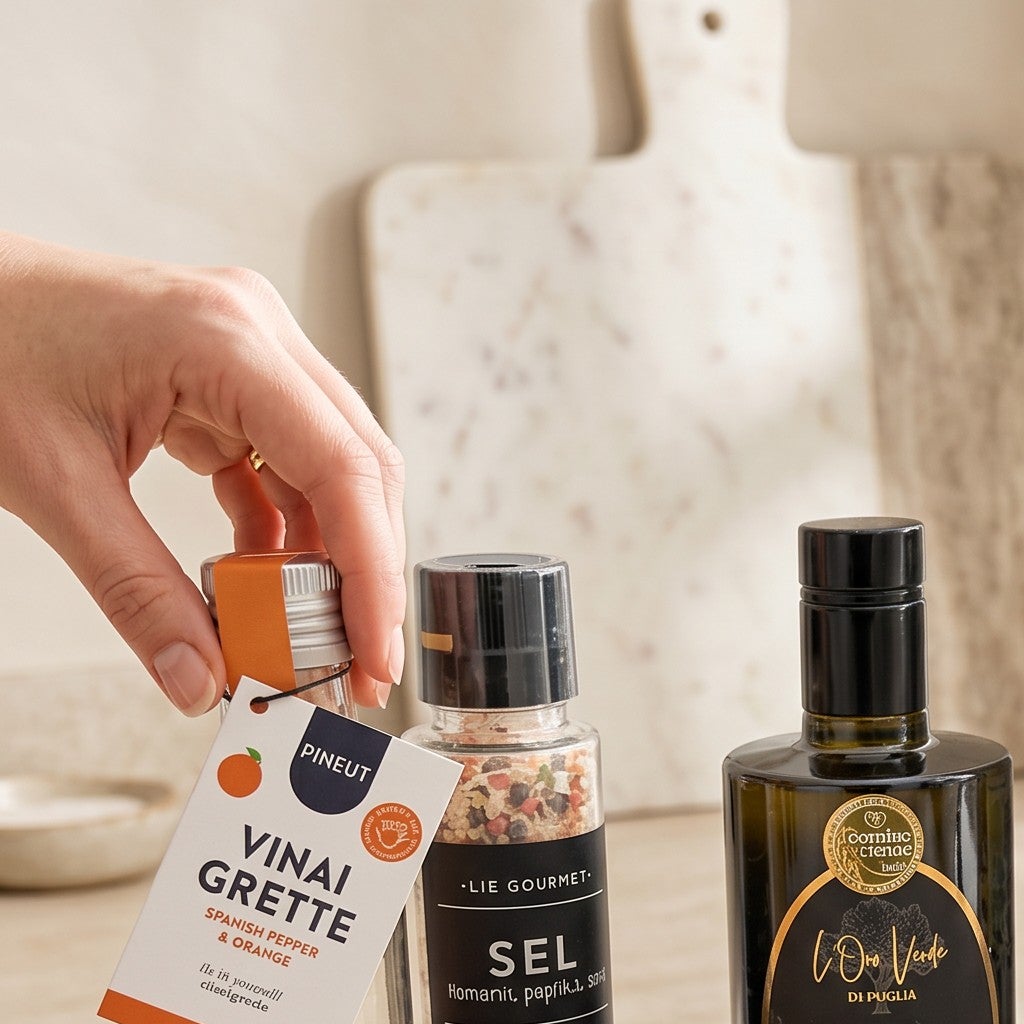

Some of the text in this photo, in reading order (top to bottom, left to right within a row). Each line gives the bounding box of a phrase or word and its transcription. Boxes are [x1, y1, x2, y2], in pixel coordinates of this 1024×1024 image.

[300, 743, 372, 783] PINEUT
[242, 823, 353, 896] VINAI
[197, 859, 358, 945] GRETTE
[204, 907, 320, 960] SPANISH PEPPER
[217, 932, 292, 968] & ORANGE
[489, 935, 577, 978] SEL
[891, 925, 949, 985] Verde
[848, 989, 917, 1003] DI PUGLIA
